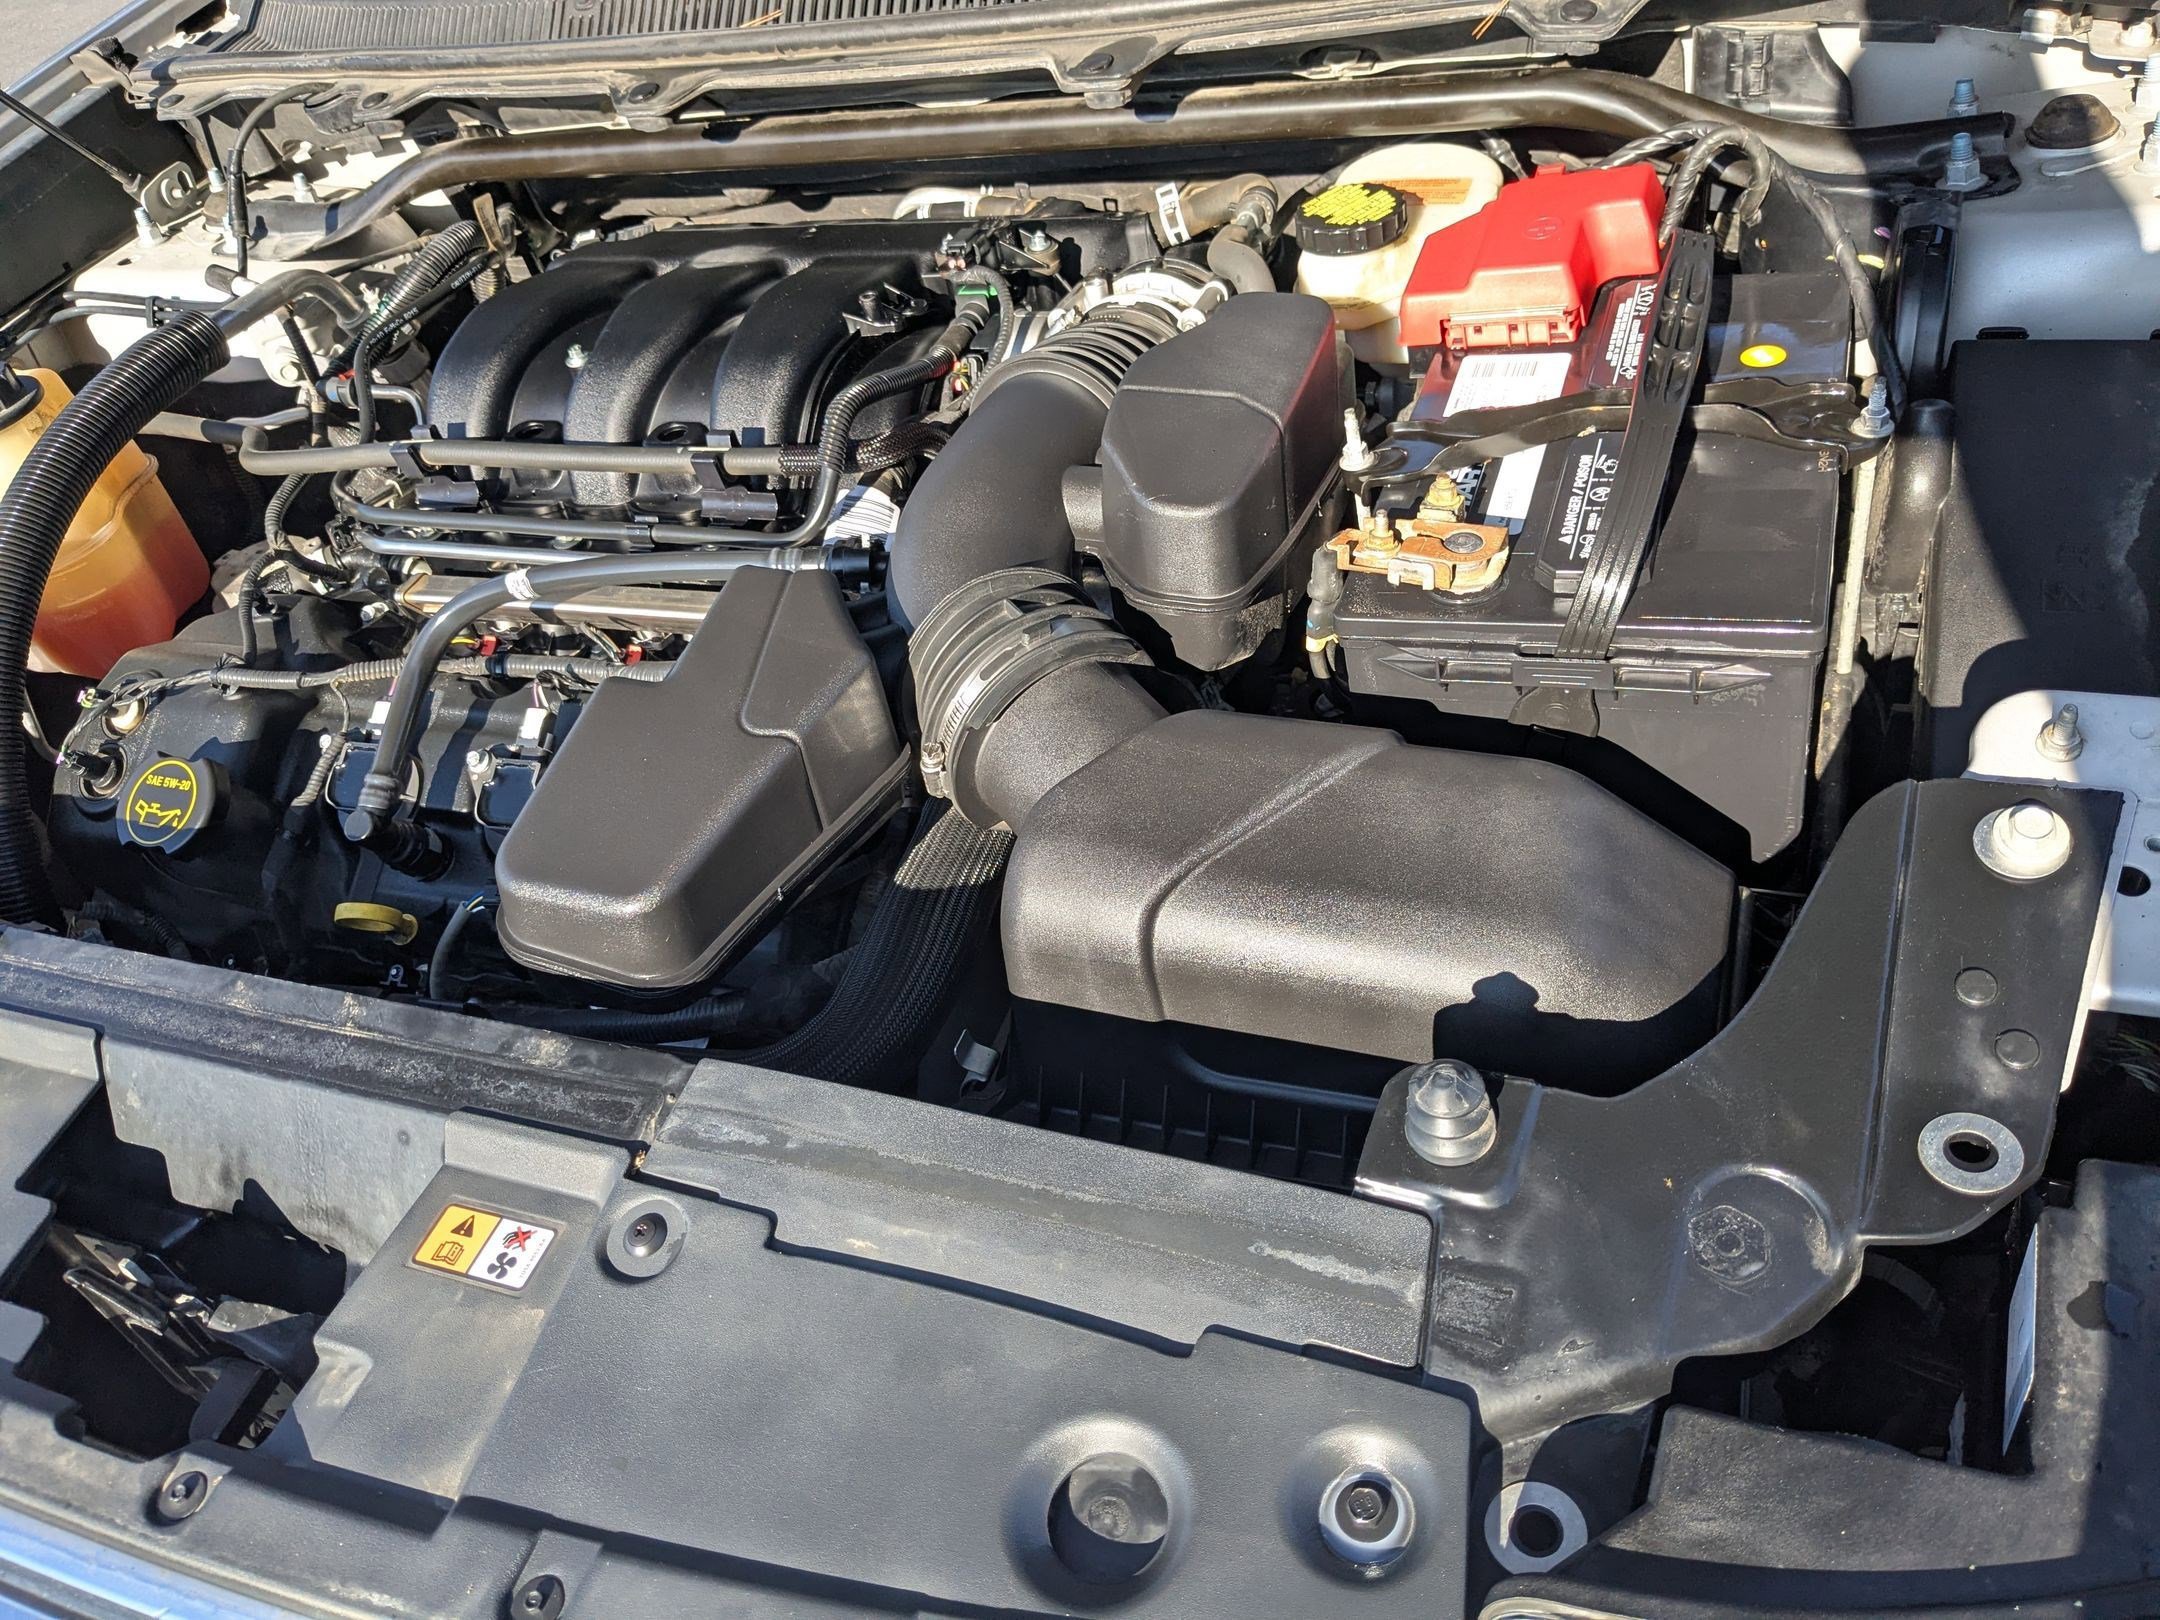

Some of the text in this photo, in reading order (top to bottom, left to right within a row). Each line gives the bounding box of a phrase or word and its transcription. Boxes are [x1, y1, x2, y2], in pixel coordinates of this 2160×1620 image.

[1561, 495, 1583, 535] DANGER
[1573, 454, 1594, 488] POISON
[146, 774, 191, 791] SAE 5W-20
